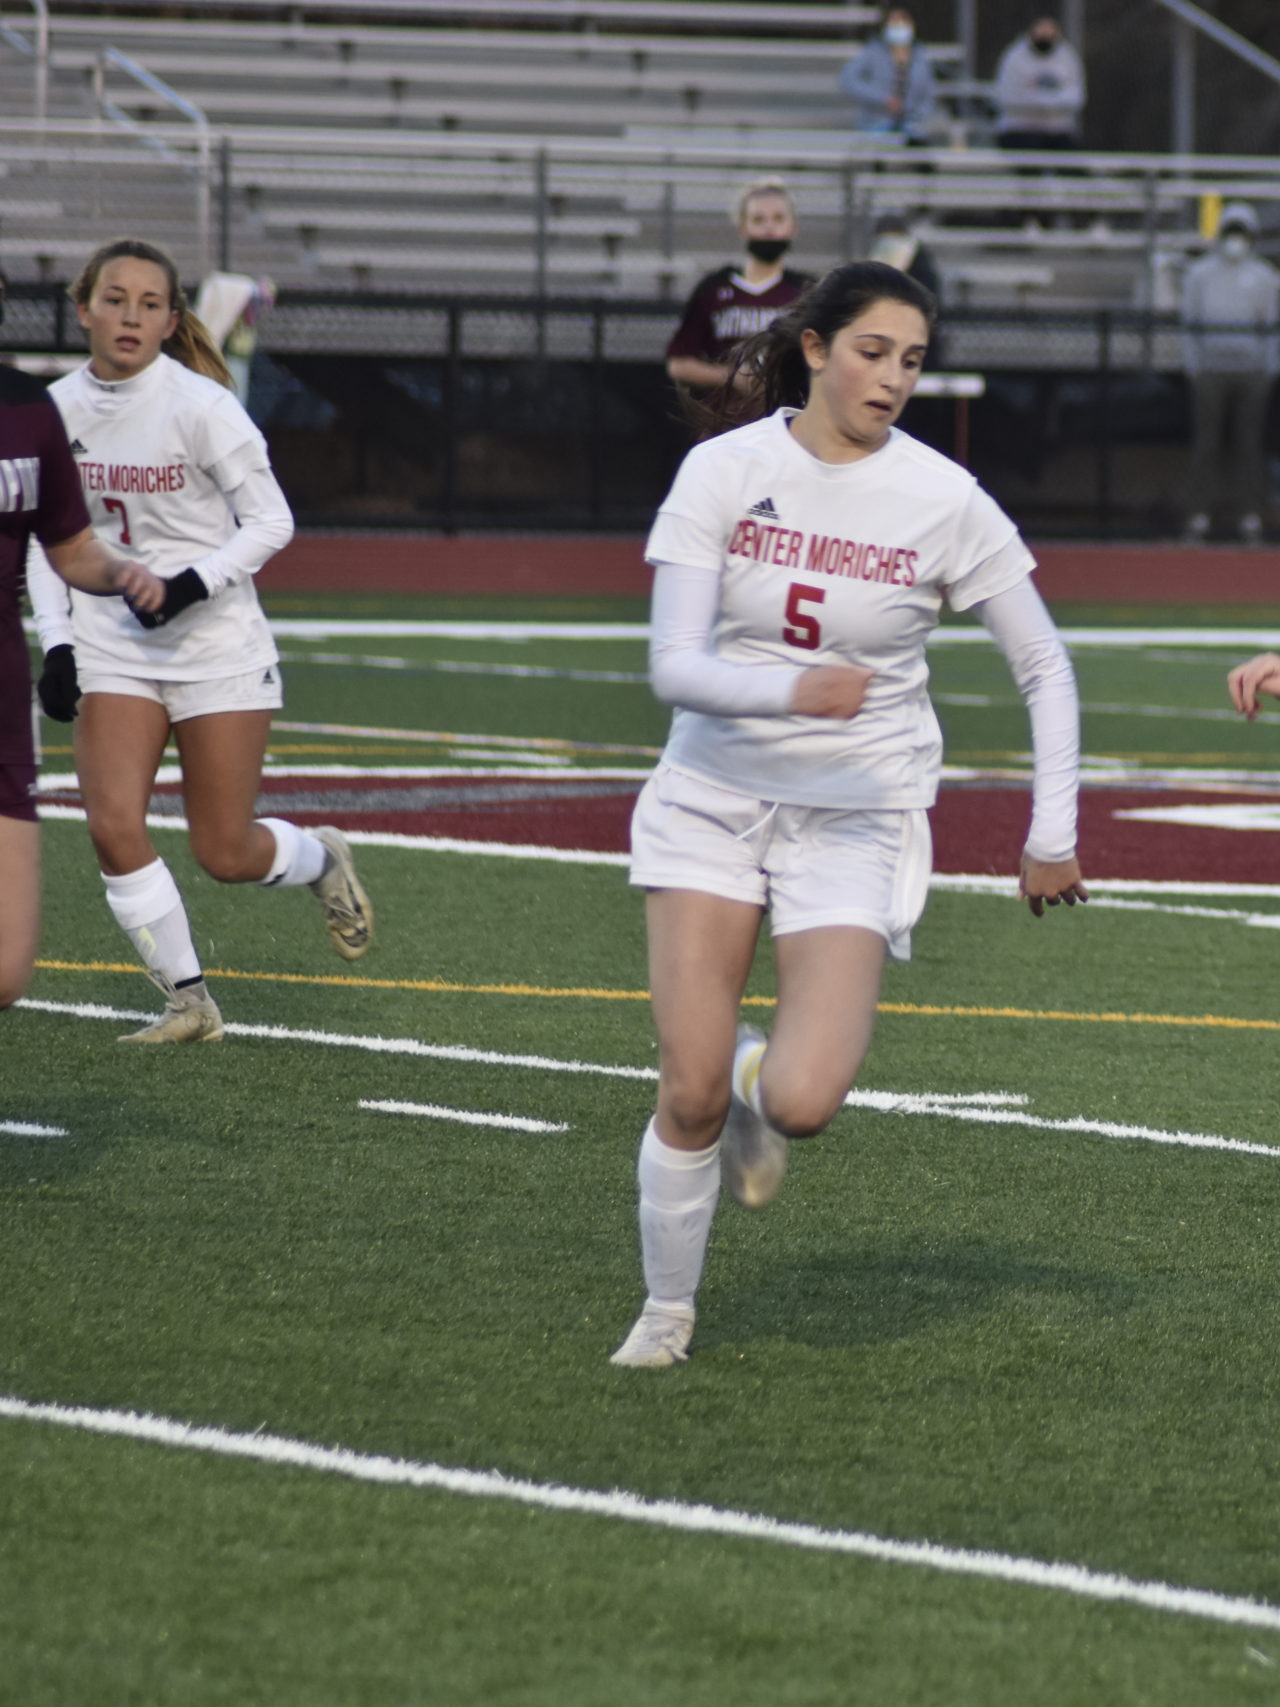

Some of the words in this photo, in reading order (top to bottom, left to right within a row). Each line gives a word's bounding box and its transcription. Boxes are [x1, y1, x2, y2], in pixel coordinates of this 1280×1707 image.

[108, 463, 186, 494] MORICHES
[101, 497, 132, 546] 7
[805, 533, 919, 587] MORICHES
[782, 581, 826, 650] 5
